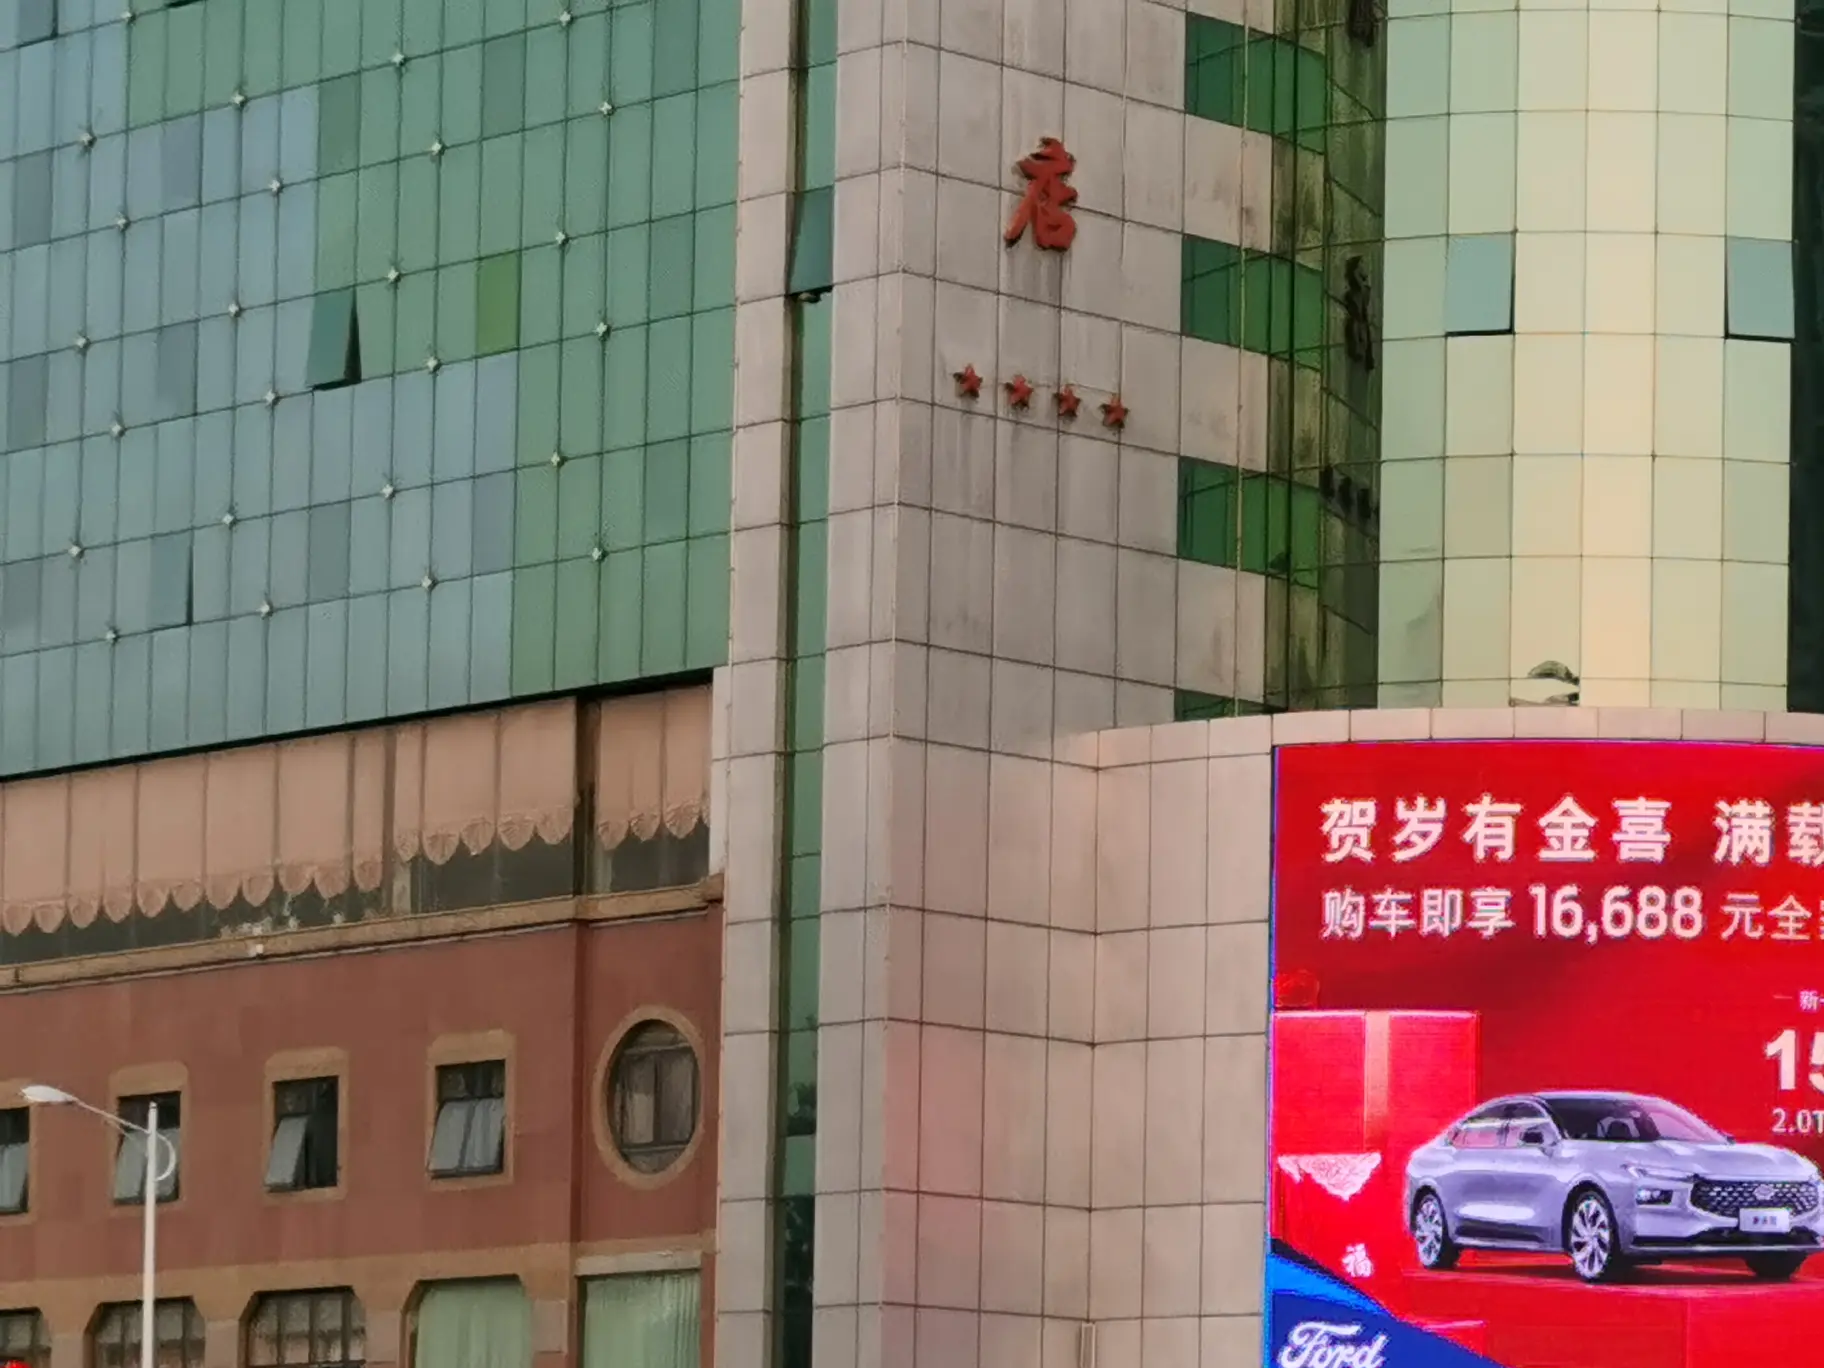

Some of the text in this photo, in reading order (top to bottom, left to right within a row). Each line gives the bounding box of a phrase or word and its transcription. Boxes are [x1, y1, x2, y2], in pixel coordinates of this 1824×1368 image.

[1319, 793, 1672, 864] 贺岁有金喜
[1322, 886, 1515, 940] 购车即享
[1530, 884, 1702, 944] 16,688
